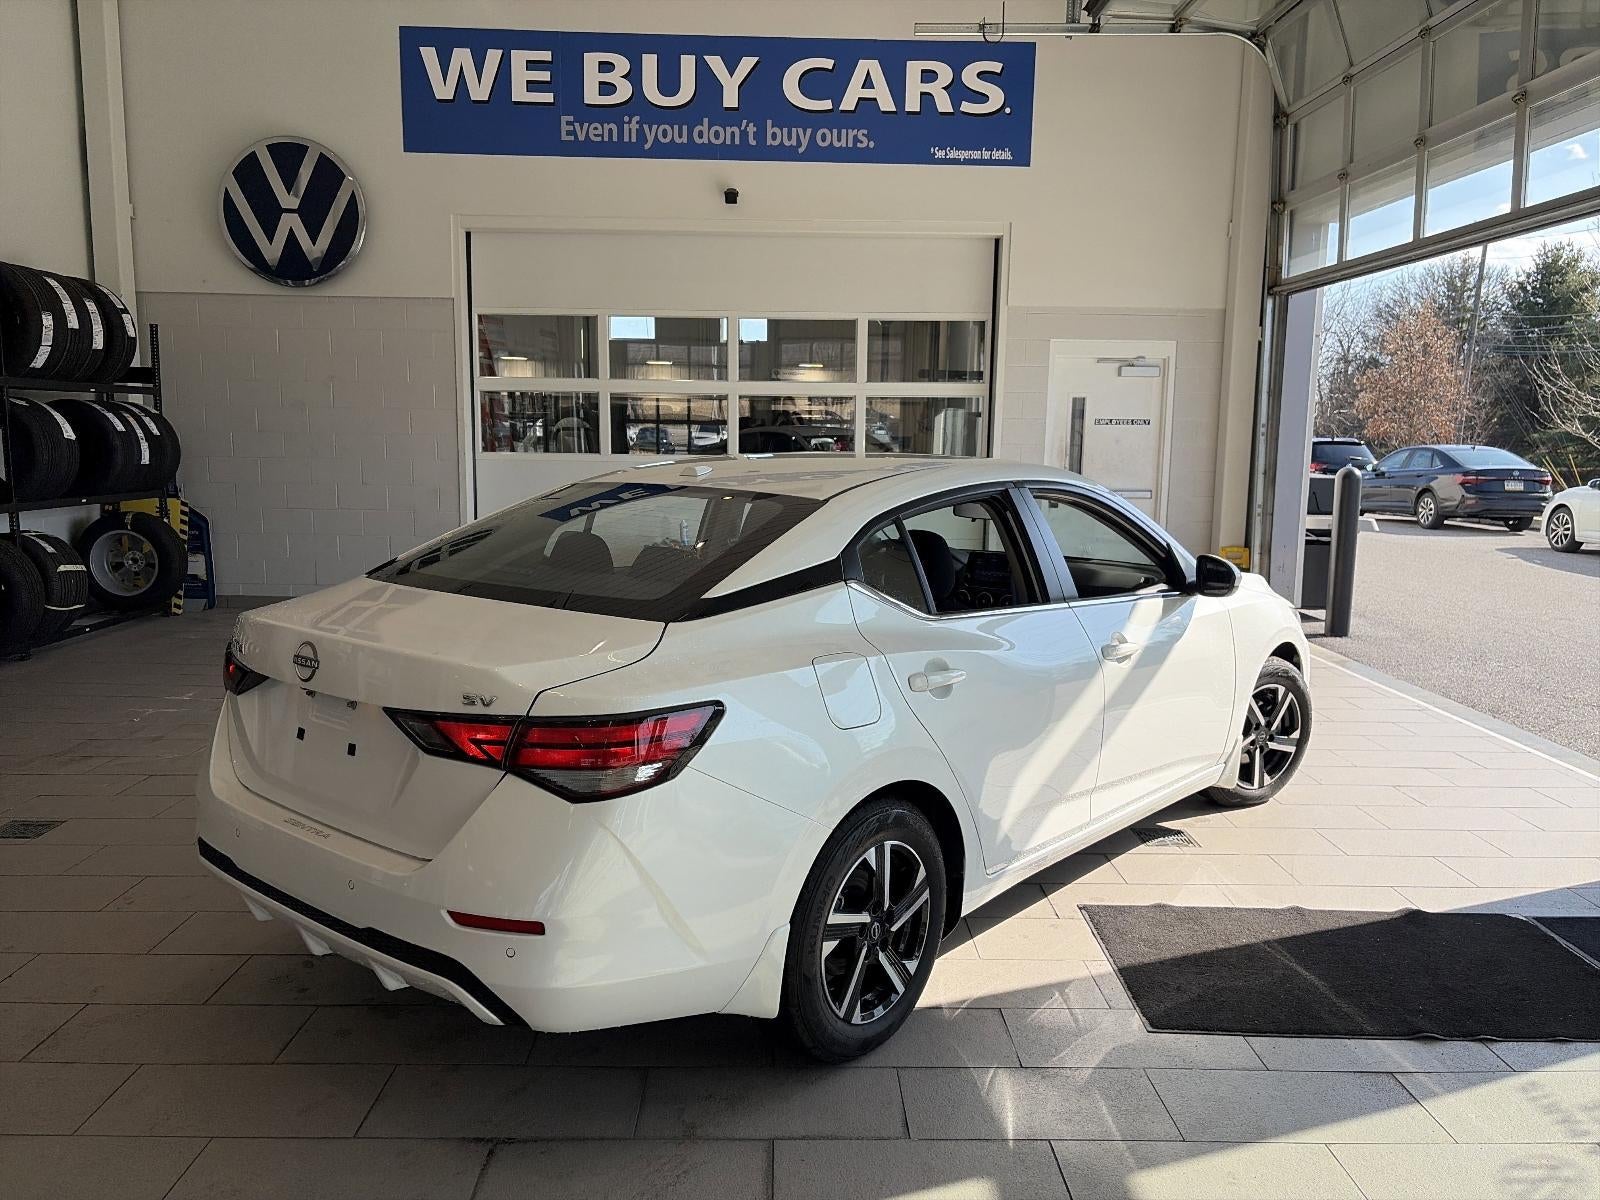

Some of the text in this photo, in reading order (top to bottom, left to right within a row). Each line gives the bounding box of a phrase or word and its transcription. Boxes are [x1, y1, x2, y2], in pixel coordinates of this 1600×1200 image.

[419, 46, 1012, 115] WE BUY CARS.
[560, 115, 875, 154] Even if you don't buy ours.
[946, 147, 981, 161] Salesperson
[982, 147, 991, 160] for
[991, 147, 1013, 160] details.
[1095, 418, 1150, 426] EMPLOYEES ONLY
[462, 693, 497, 707] SV
